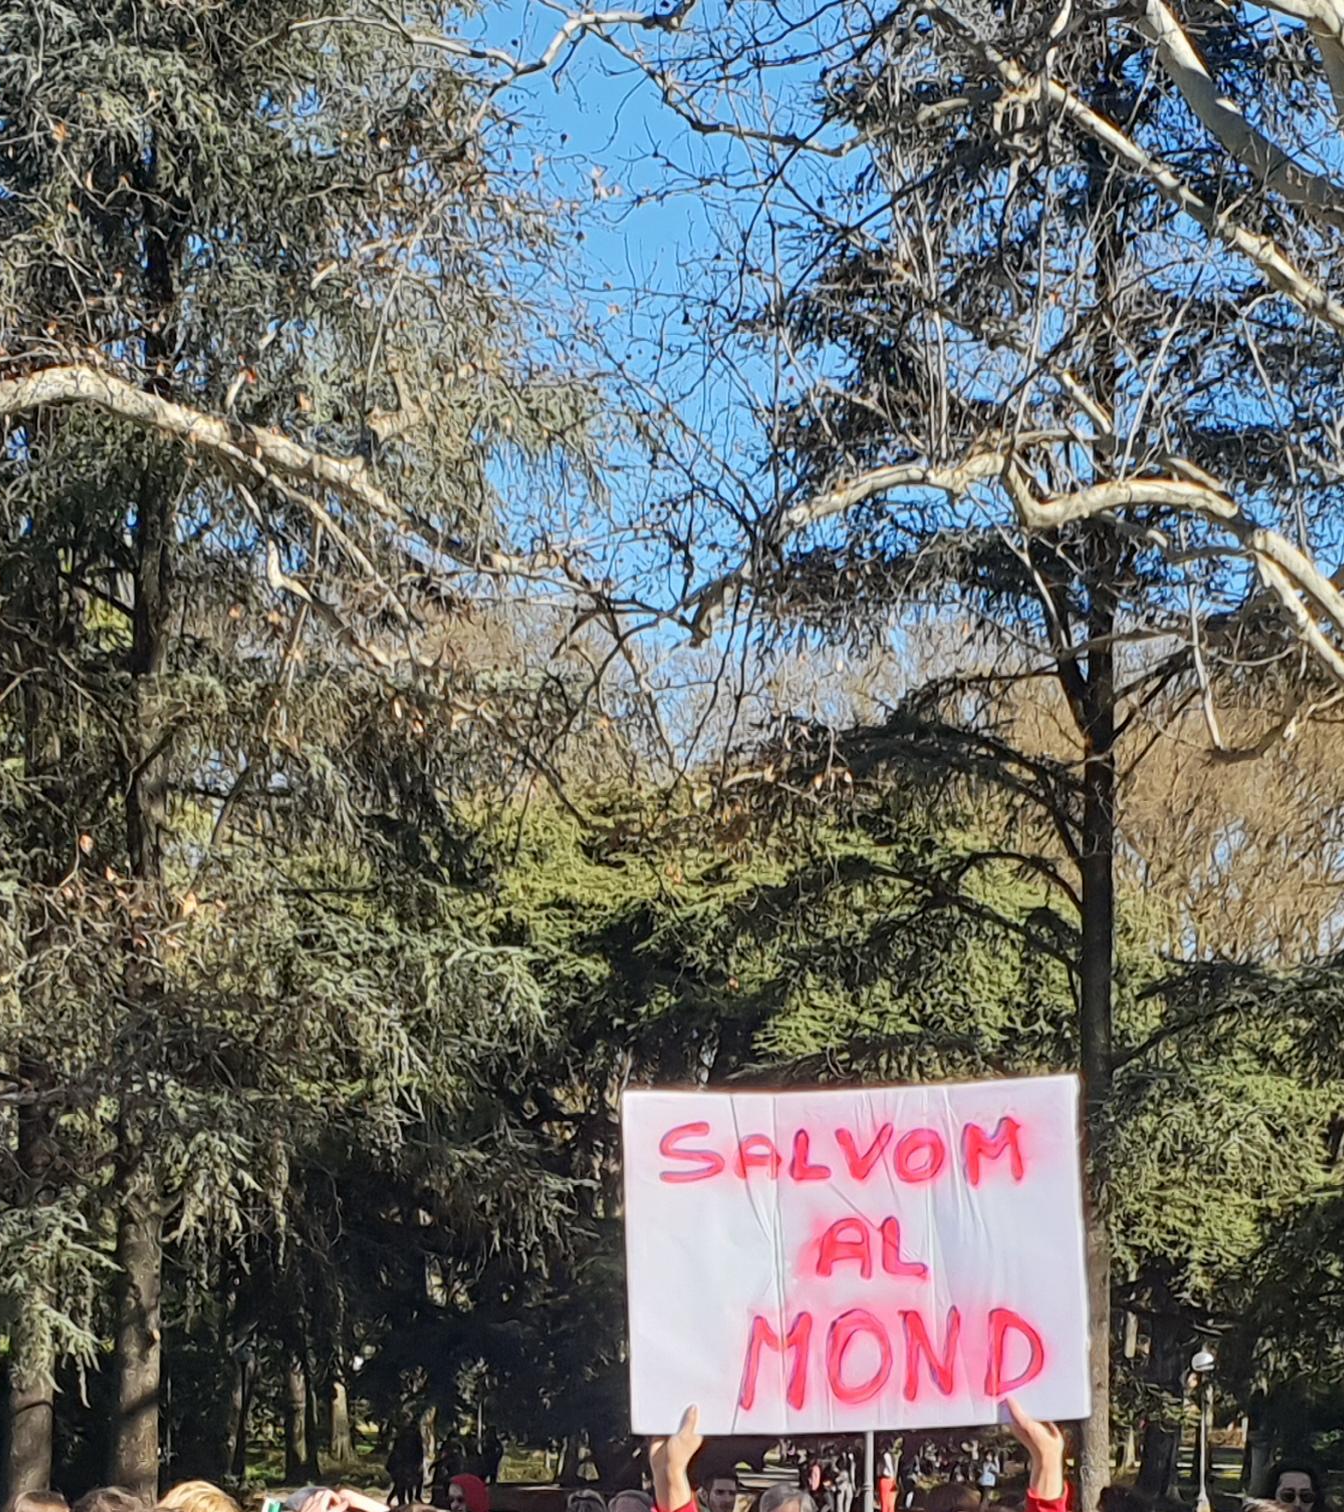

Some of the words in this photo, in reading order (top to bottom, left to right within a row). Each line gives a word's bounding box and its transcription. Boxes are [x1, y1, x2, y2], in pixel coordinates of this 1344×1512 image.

[658, 1115, 1026, 1188] SALVOM
[814, 1215, 929, 1280] AL
[739, 1304, 1046, 1411] MOND
